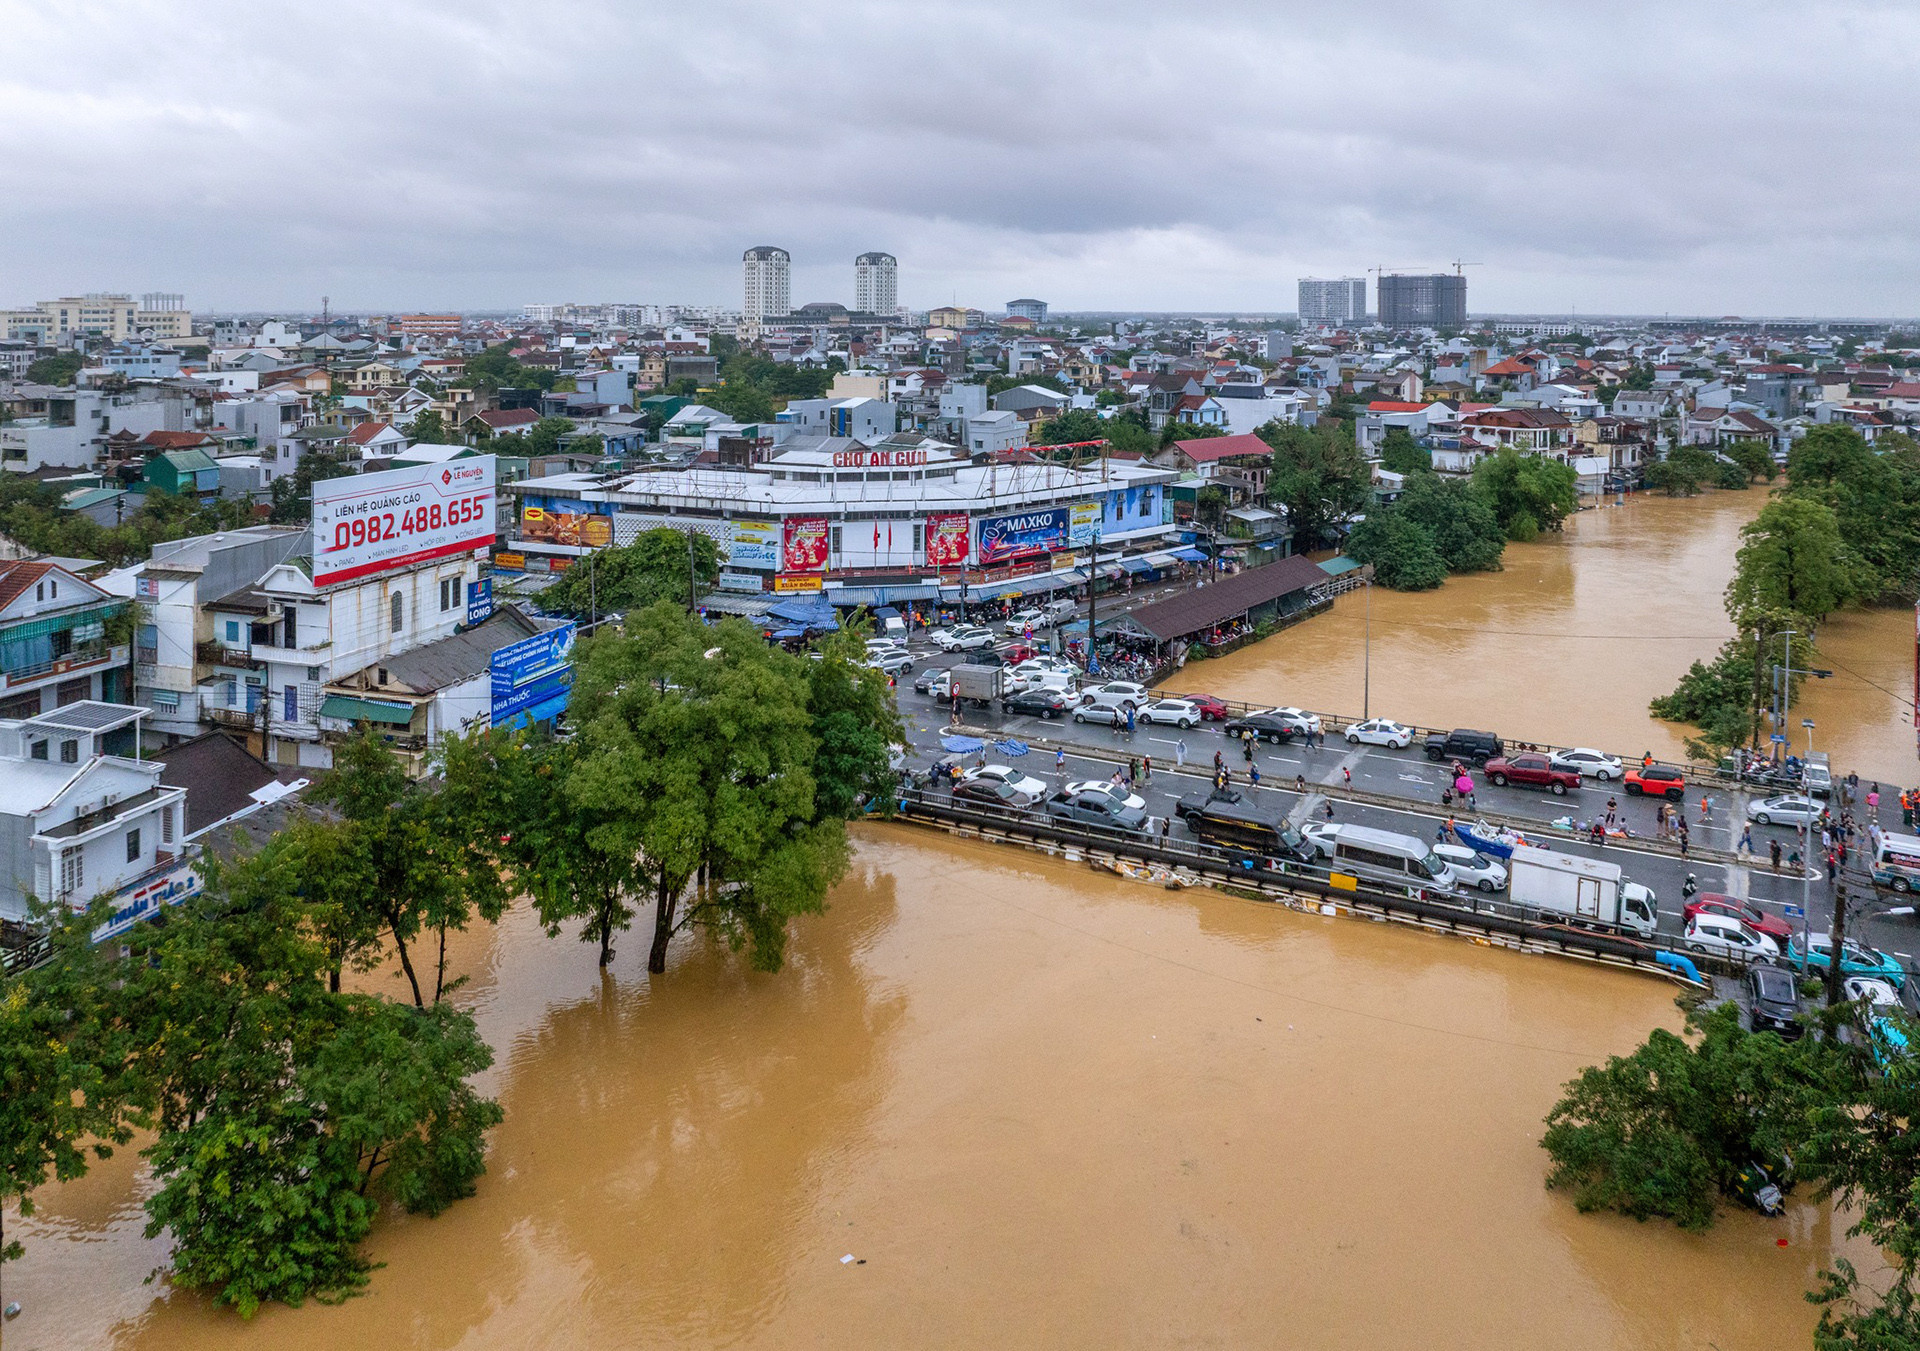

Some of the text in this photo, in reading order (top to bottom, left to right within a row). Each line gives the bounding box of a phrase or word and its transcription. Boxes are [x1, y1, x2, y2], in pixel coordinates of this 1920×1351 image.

[833, 451, 927, 468] CHỢ AN CỰU
[335, 504, 354, 518] LIÊN
[356, 501, 368, 514] HỆ
[402, 492, 421, 504] CÁO
[334, 498, 484, 550] 0982.488.655
[1007, 513, 1052, 531] MAXKO
[469, 606, 491, 620] LONG
[508, 688, 531, 703] THUỐC
[187, 876, 195, 889] 2
